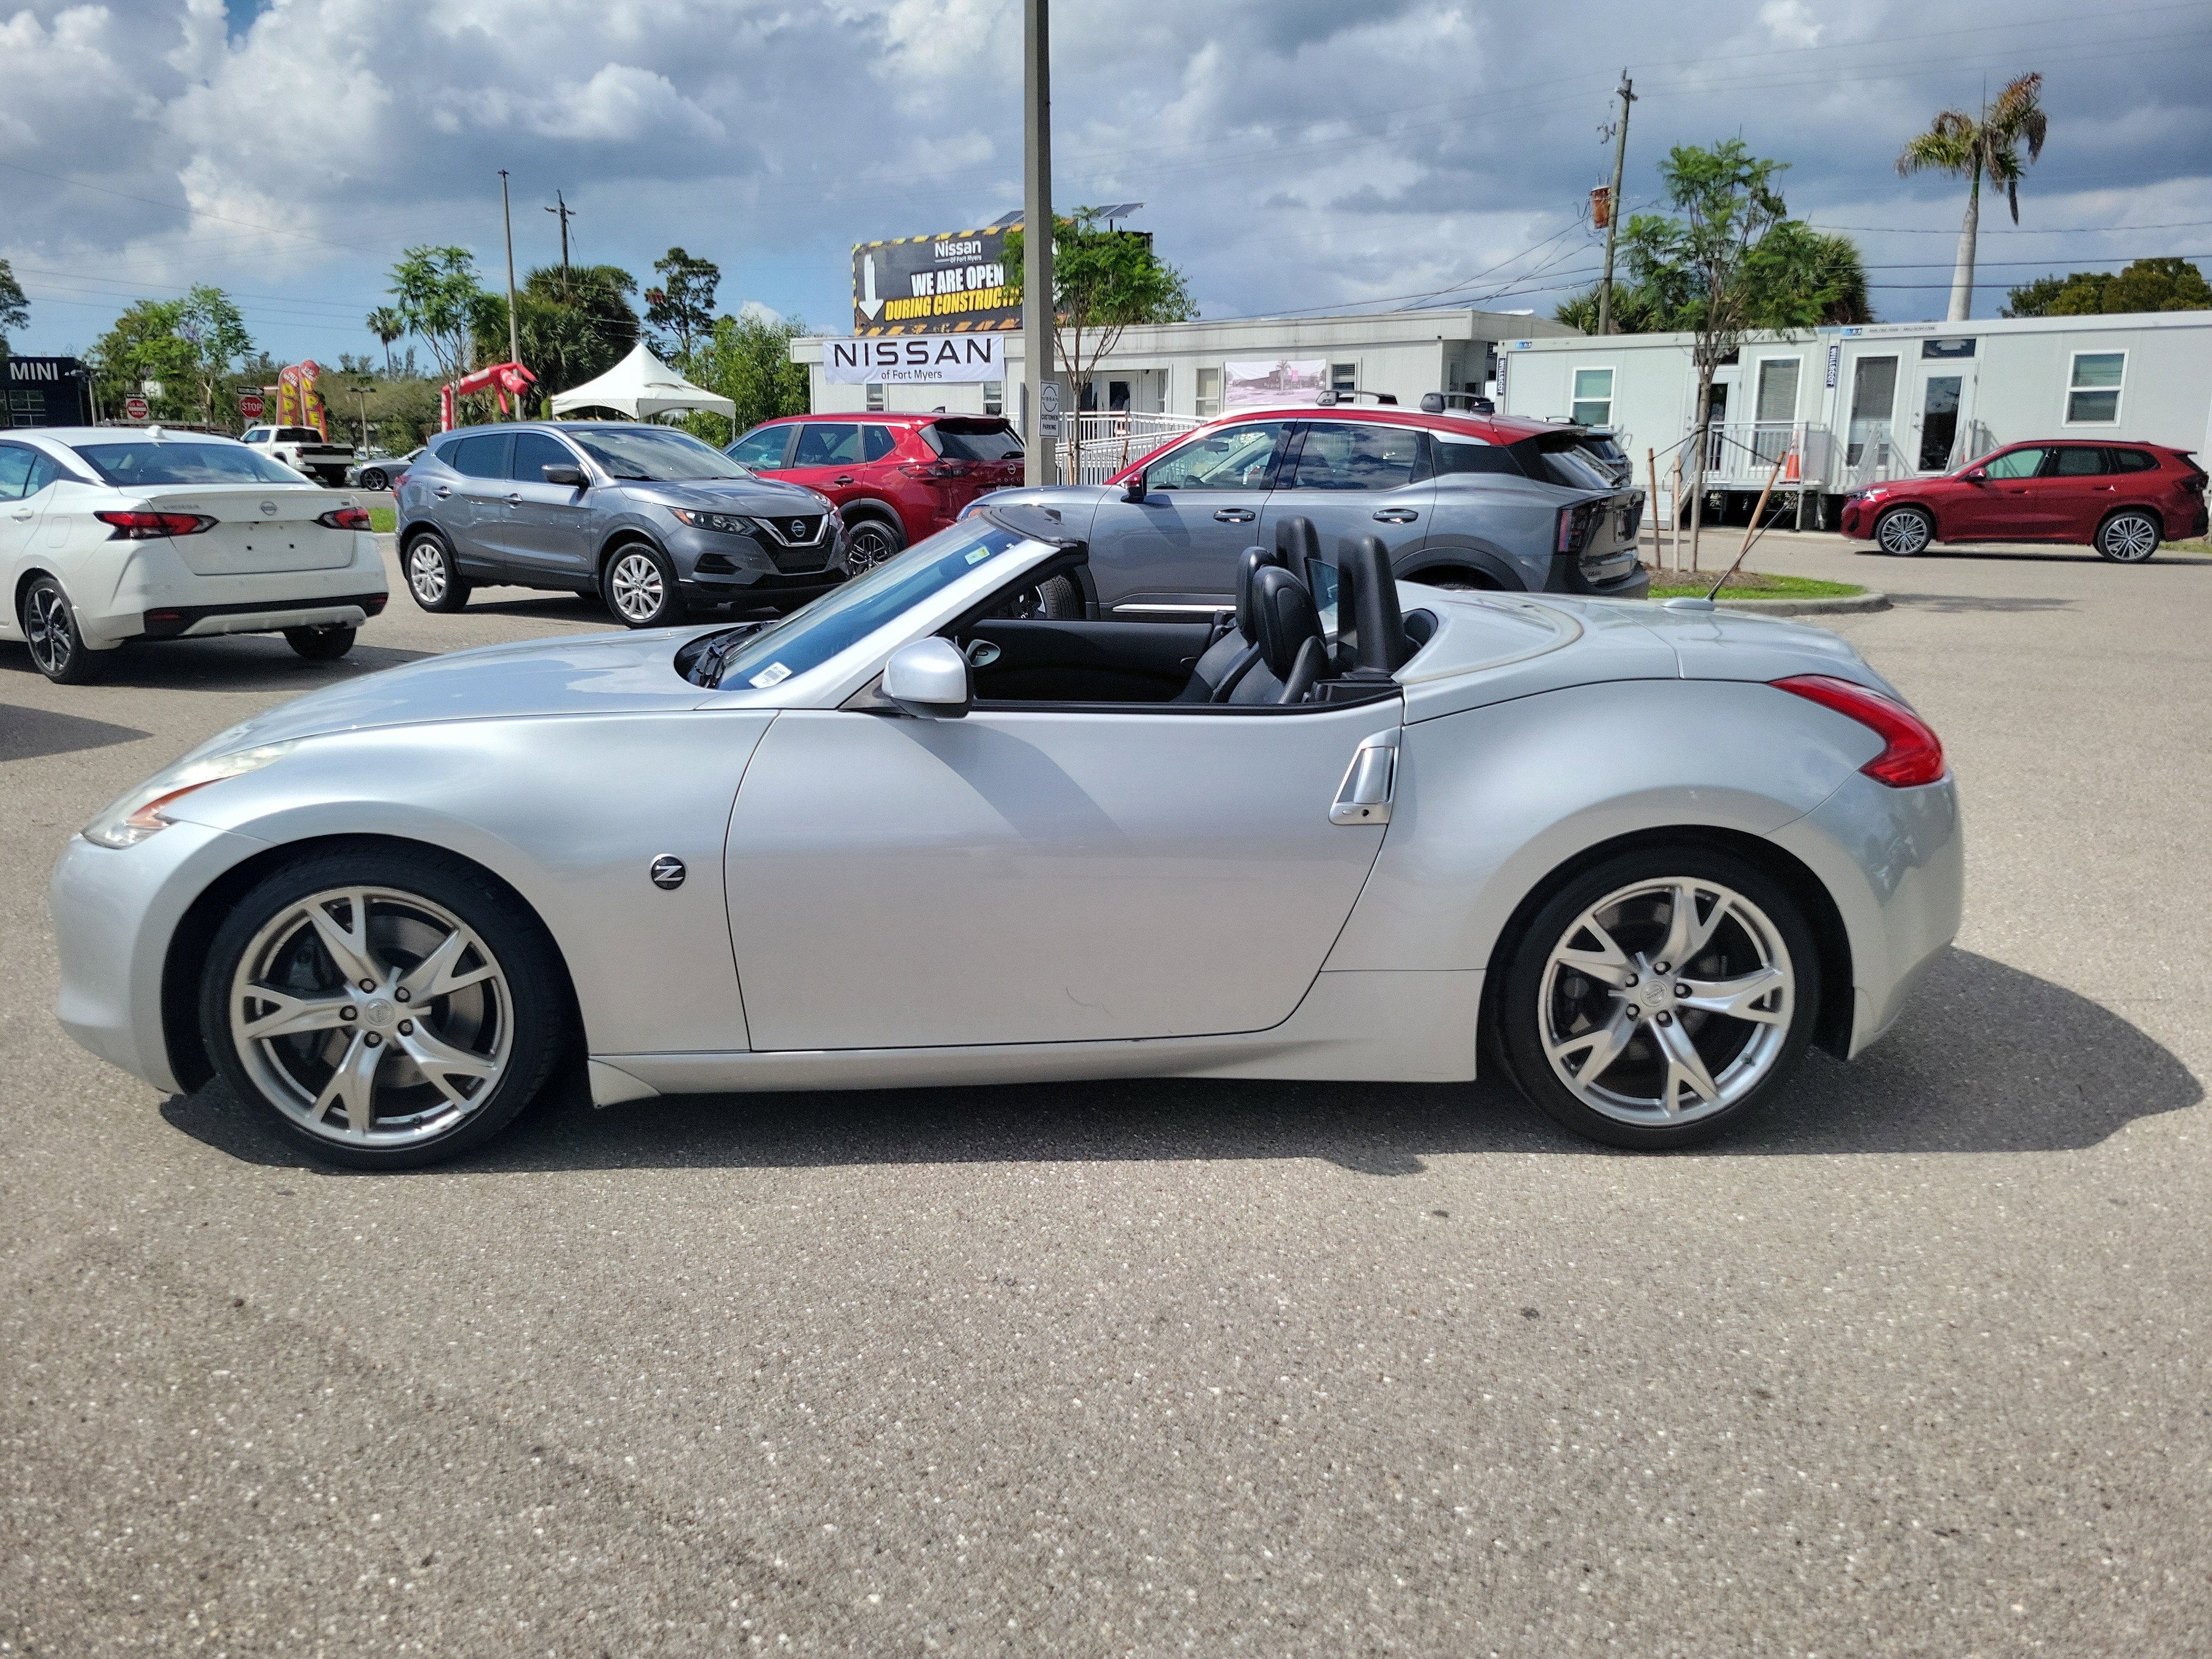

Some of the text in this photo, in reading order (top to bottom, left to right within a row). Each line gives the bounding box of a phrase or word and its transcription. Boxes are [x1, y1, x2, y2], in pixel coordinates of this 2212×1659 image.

[934, 240, 981, 258] Nissan
[911, 263, 1004, 297] WE ARE OPEN
[884, 295, 932, 321] DURING
[834, 338, 991, 368] NISSAN
[10, 362, 59, 380] MINI
[881, 369, 943, 381] of Fort Myers
[1497, 359, 1505, 394] WILLSCOT
[1827, 346, 1838, 386] WILLSCOT
[241, 402, 262, 411] STOP
[654, 865, 684, 881] Z
